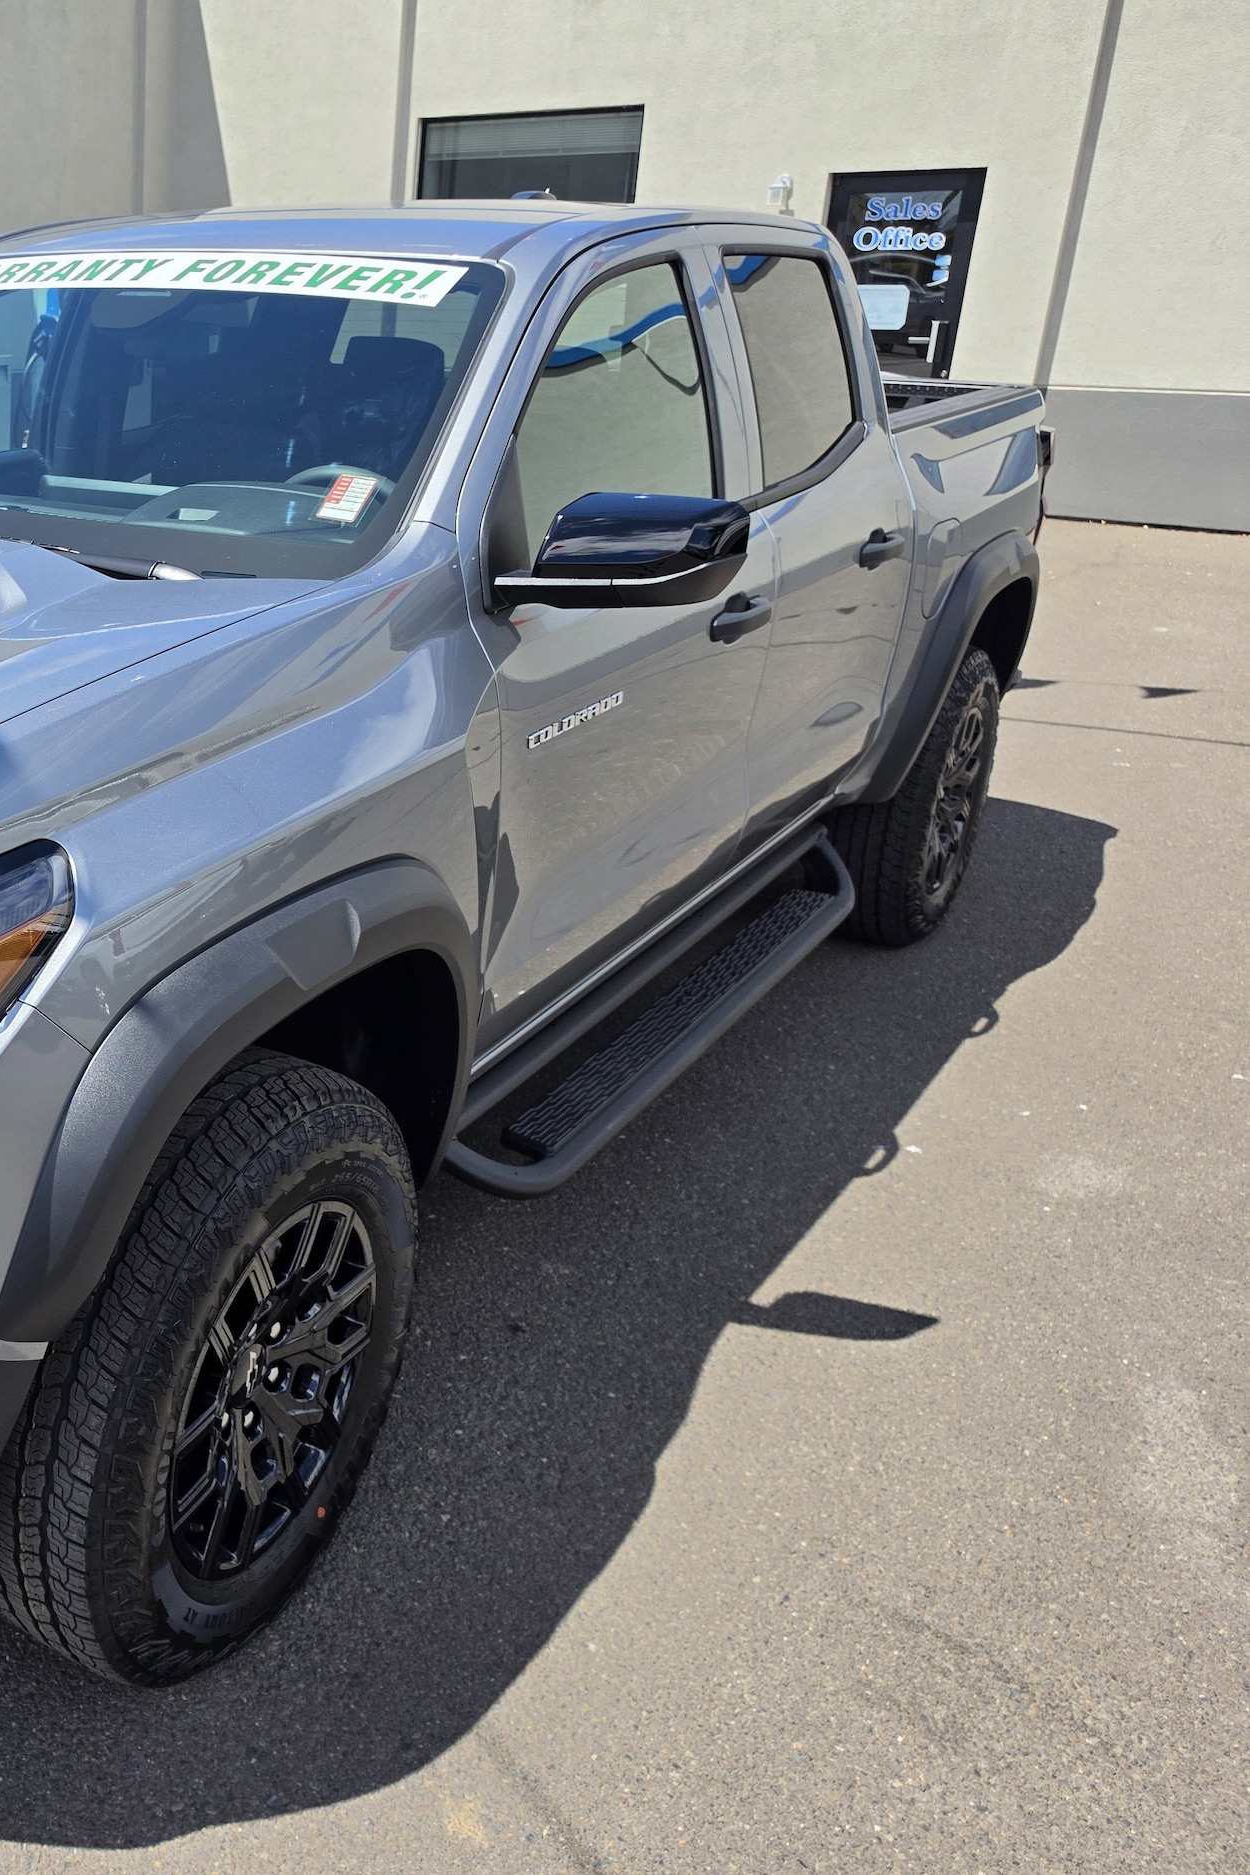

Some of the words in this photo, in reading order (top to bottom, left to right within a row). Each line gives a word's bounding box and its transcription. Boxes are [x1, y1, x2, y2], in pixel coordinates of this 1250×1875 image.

[864, 196, 943, 221] Sales
[852, 226, 946, 251] Office
[171, 258, 447, 300] FOREVER!
[527, 690, 624, 750] COLORADO
